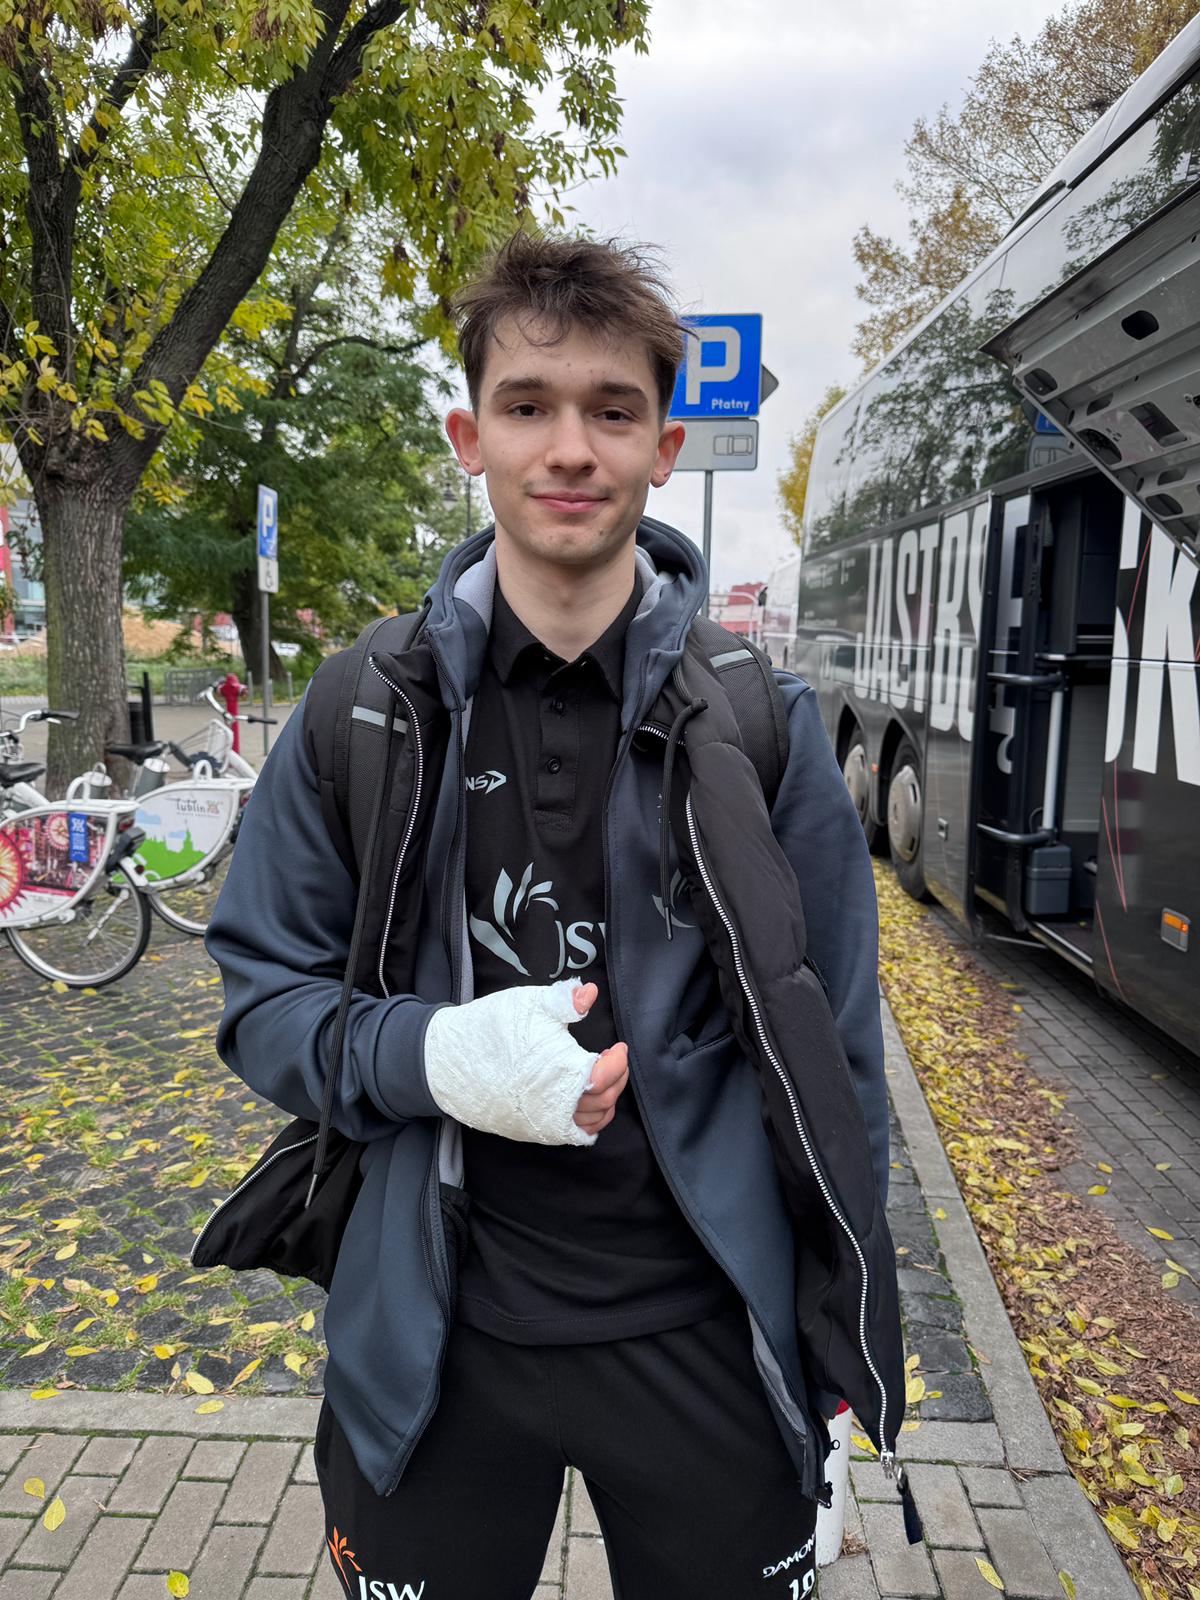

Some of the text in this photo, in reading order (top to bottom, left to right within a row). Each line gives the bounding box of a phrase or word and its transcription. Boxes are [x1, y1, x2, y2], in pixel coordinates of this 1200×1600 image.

[685, 326, 741, 405] P
[711, 398, 750, 412] Płatny
[262, 495, 274, 537] P
[549, 920, 607, 979] JS
